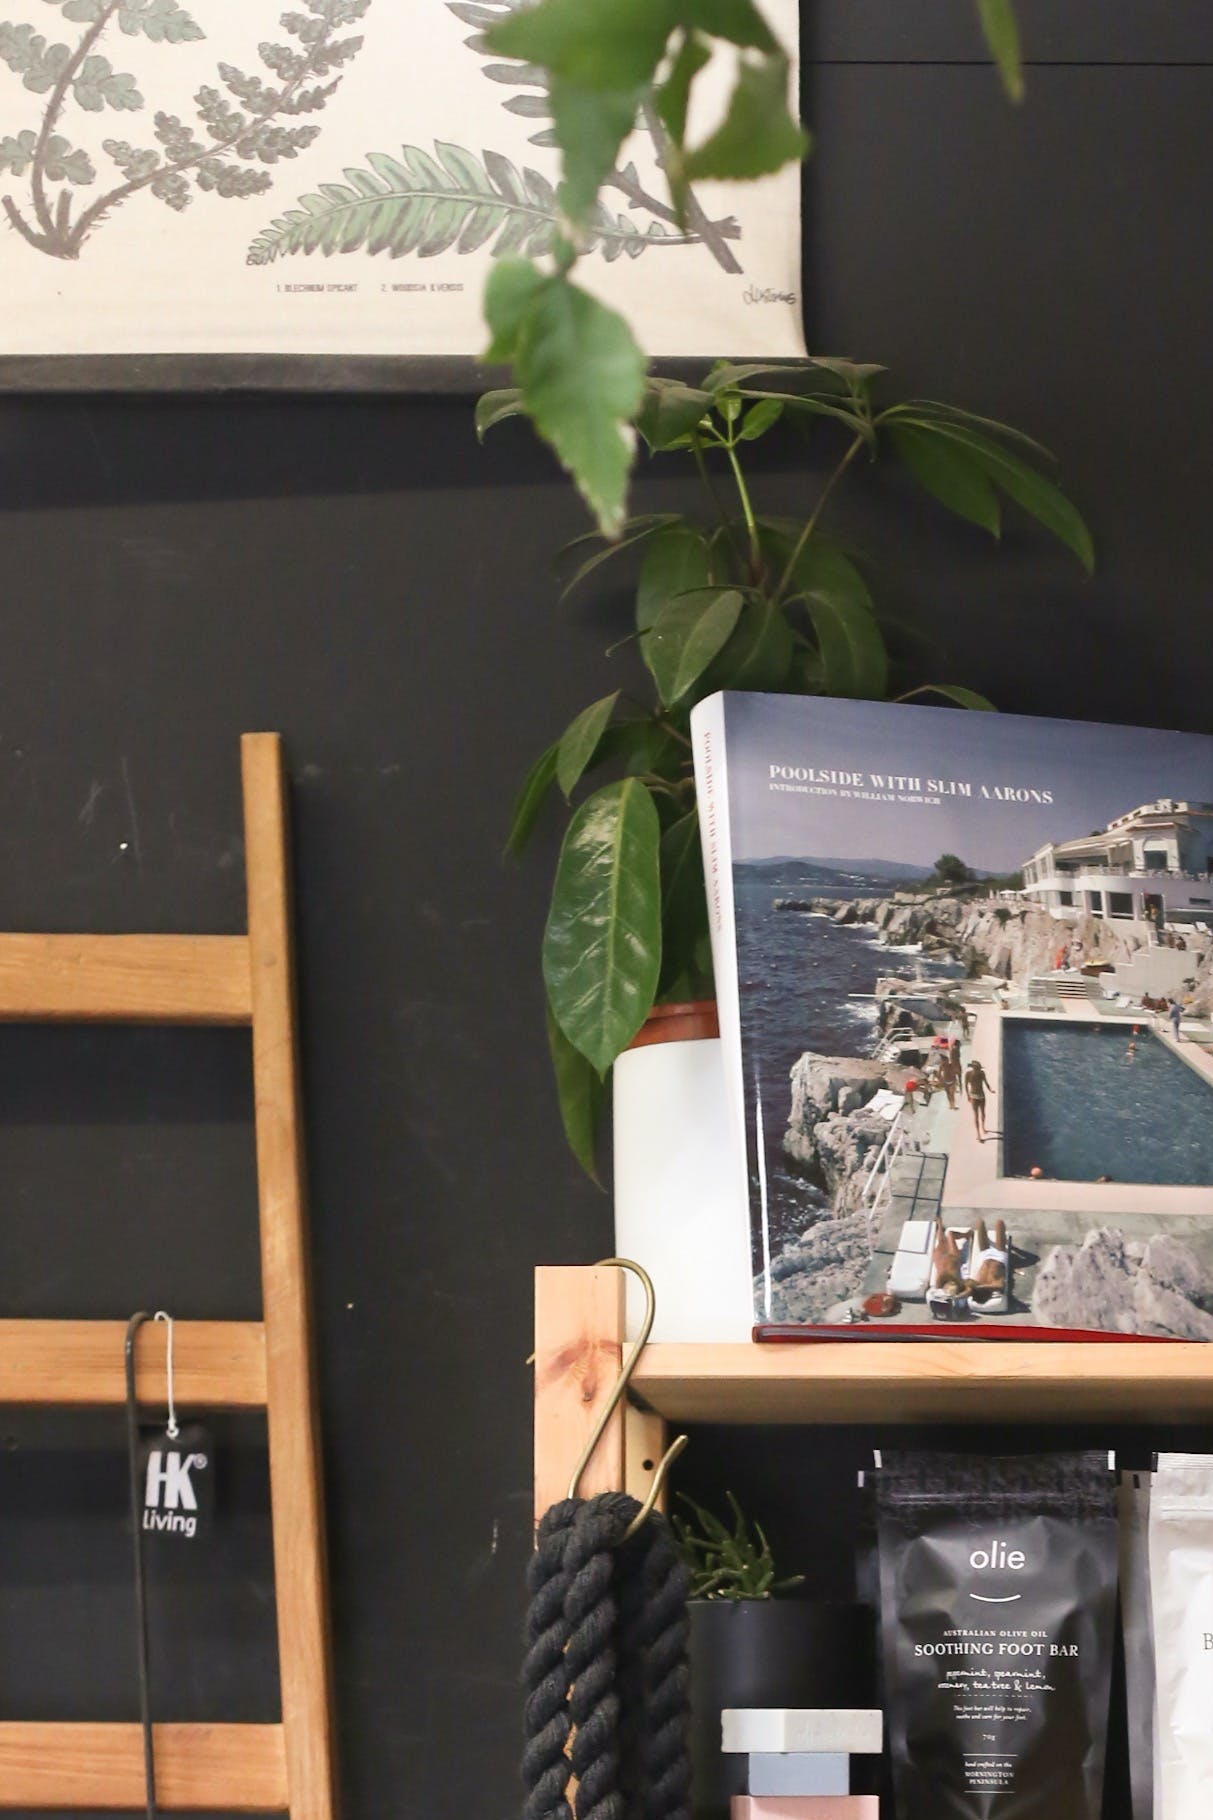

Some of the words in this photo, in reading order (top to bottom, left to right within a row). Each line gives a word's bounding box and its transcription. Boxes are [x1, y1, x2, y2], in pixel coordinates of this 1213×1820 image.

[769, 764, 865, 788] POOLSIDE
[870, 774, 921, 792] WITH
[927, 778, 972, 797] SLIM
[980, 785, 1054, 804] AARONS
[969, 1540, 1026, 1570] olie
[944, 1629, 996, 1638] AUSTRALIAN
[999, 1630, 1028, 1638] OLIVE
[1031, 1630, 1048, 1638] OIL
[914, 1643, 994, 1656] SOOTHING
[998, 1643, 1045, 1656] FOOT
[1049, 1644, 1079, 1657] BAR
